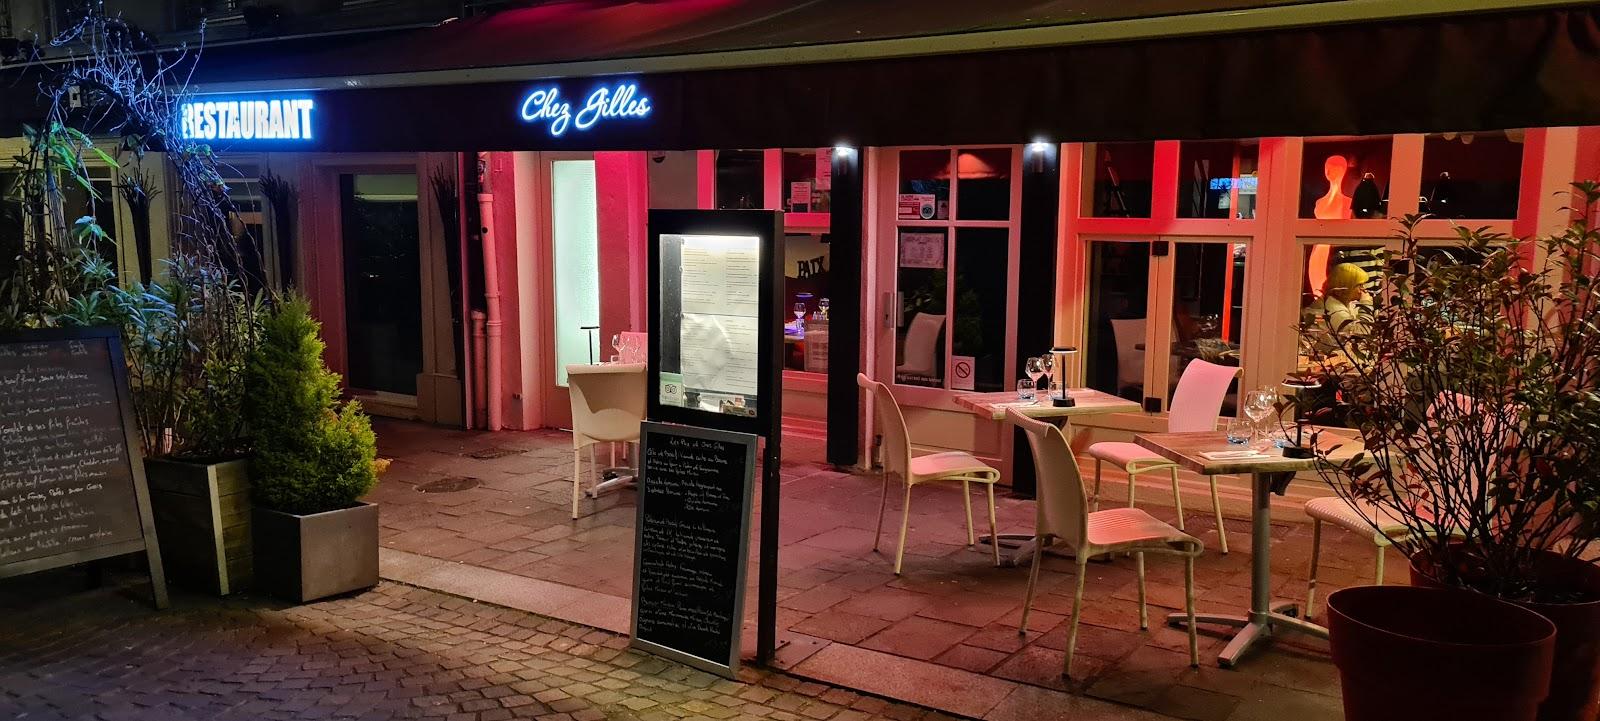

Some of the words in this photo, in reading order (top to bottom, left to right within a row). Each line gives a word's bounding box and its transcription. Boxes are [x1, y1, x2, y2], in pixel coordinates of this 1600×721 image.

[181, 99, 314, 140] RESTAURANT
[521, 86, 572, 137] Chez
[575, 84, 651, 129] Gilles
